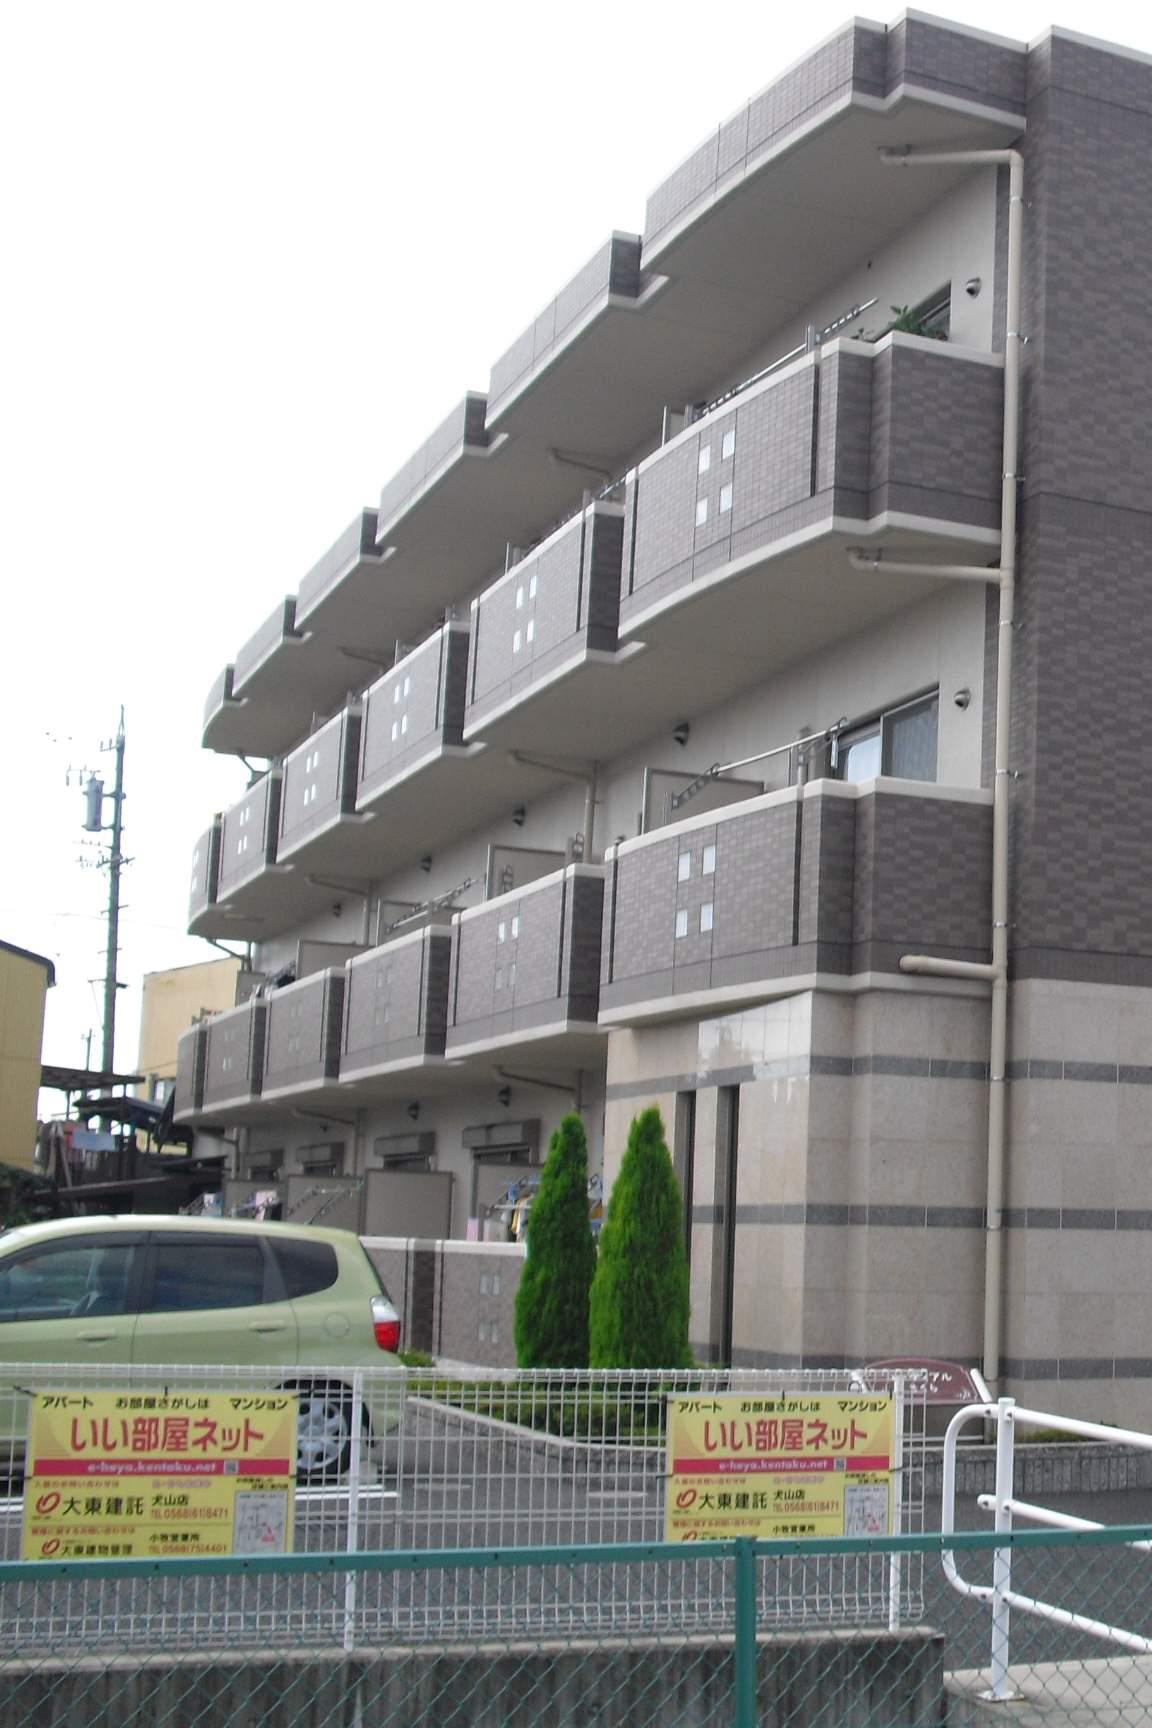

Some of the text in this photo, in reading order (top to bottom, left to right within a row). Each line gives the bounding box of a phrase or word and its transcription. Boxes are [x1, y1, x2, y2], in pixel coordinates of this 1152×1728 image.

[42, 1396, 288, 1410] アパート お部屋さがしは マンション
[678, 1401, 887, 1413] アパート お部屋さがしは マンション
[70, 1416, 265, 1453] いい部屋ネット
[703, 1419, 868, 1452] いい部屋ネット
[87, 1460, 217, 1475] e-heya.kentaku.net
[719, 1459, 828, 1473] e-heya.kentaku.net
[151, 1494, 189, 1506] 犬山店
[698, 1492, 768, 1511] 大東建託
[773, 1490, 805, 1501] 犬山店
[62, 1496, 145, 1516] 大東建託
